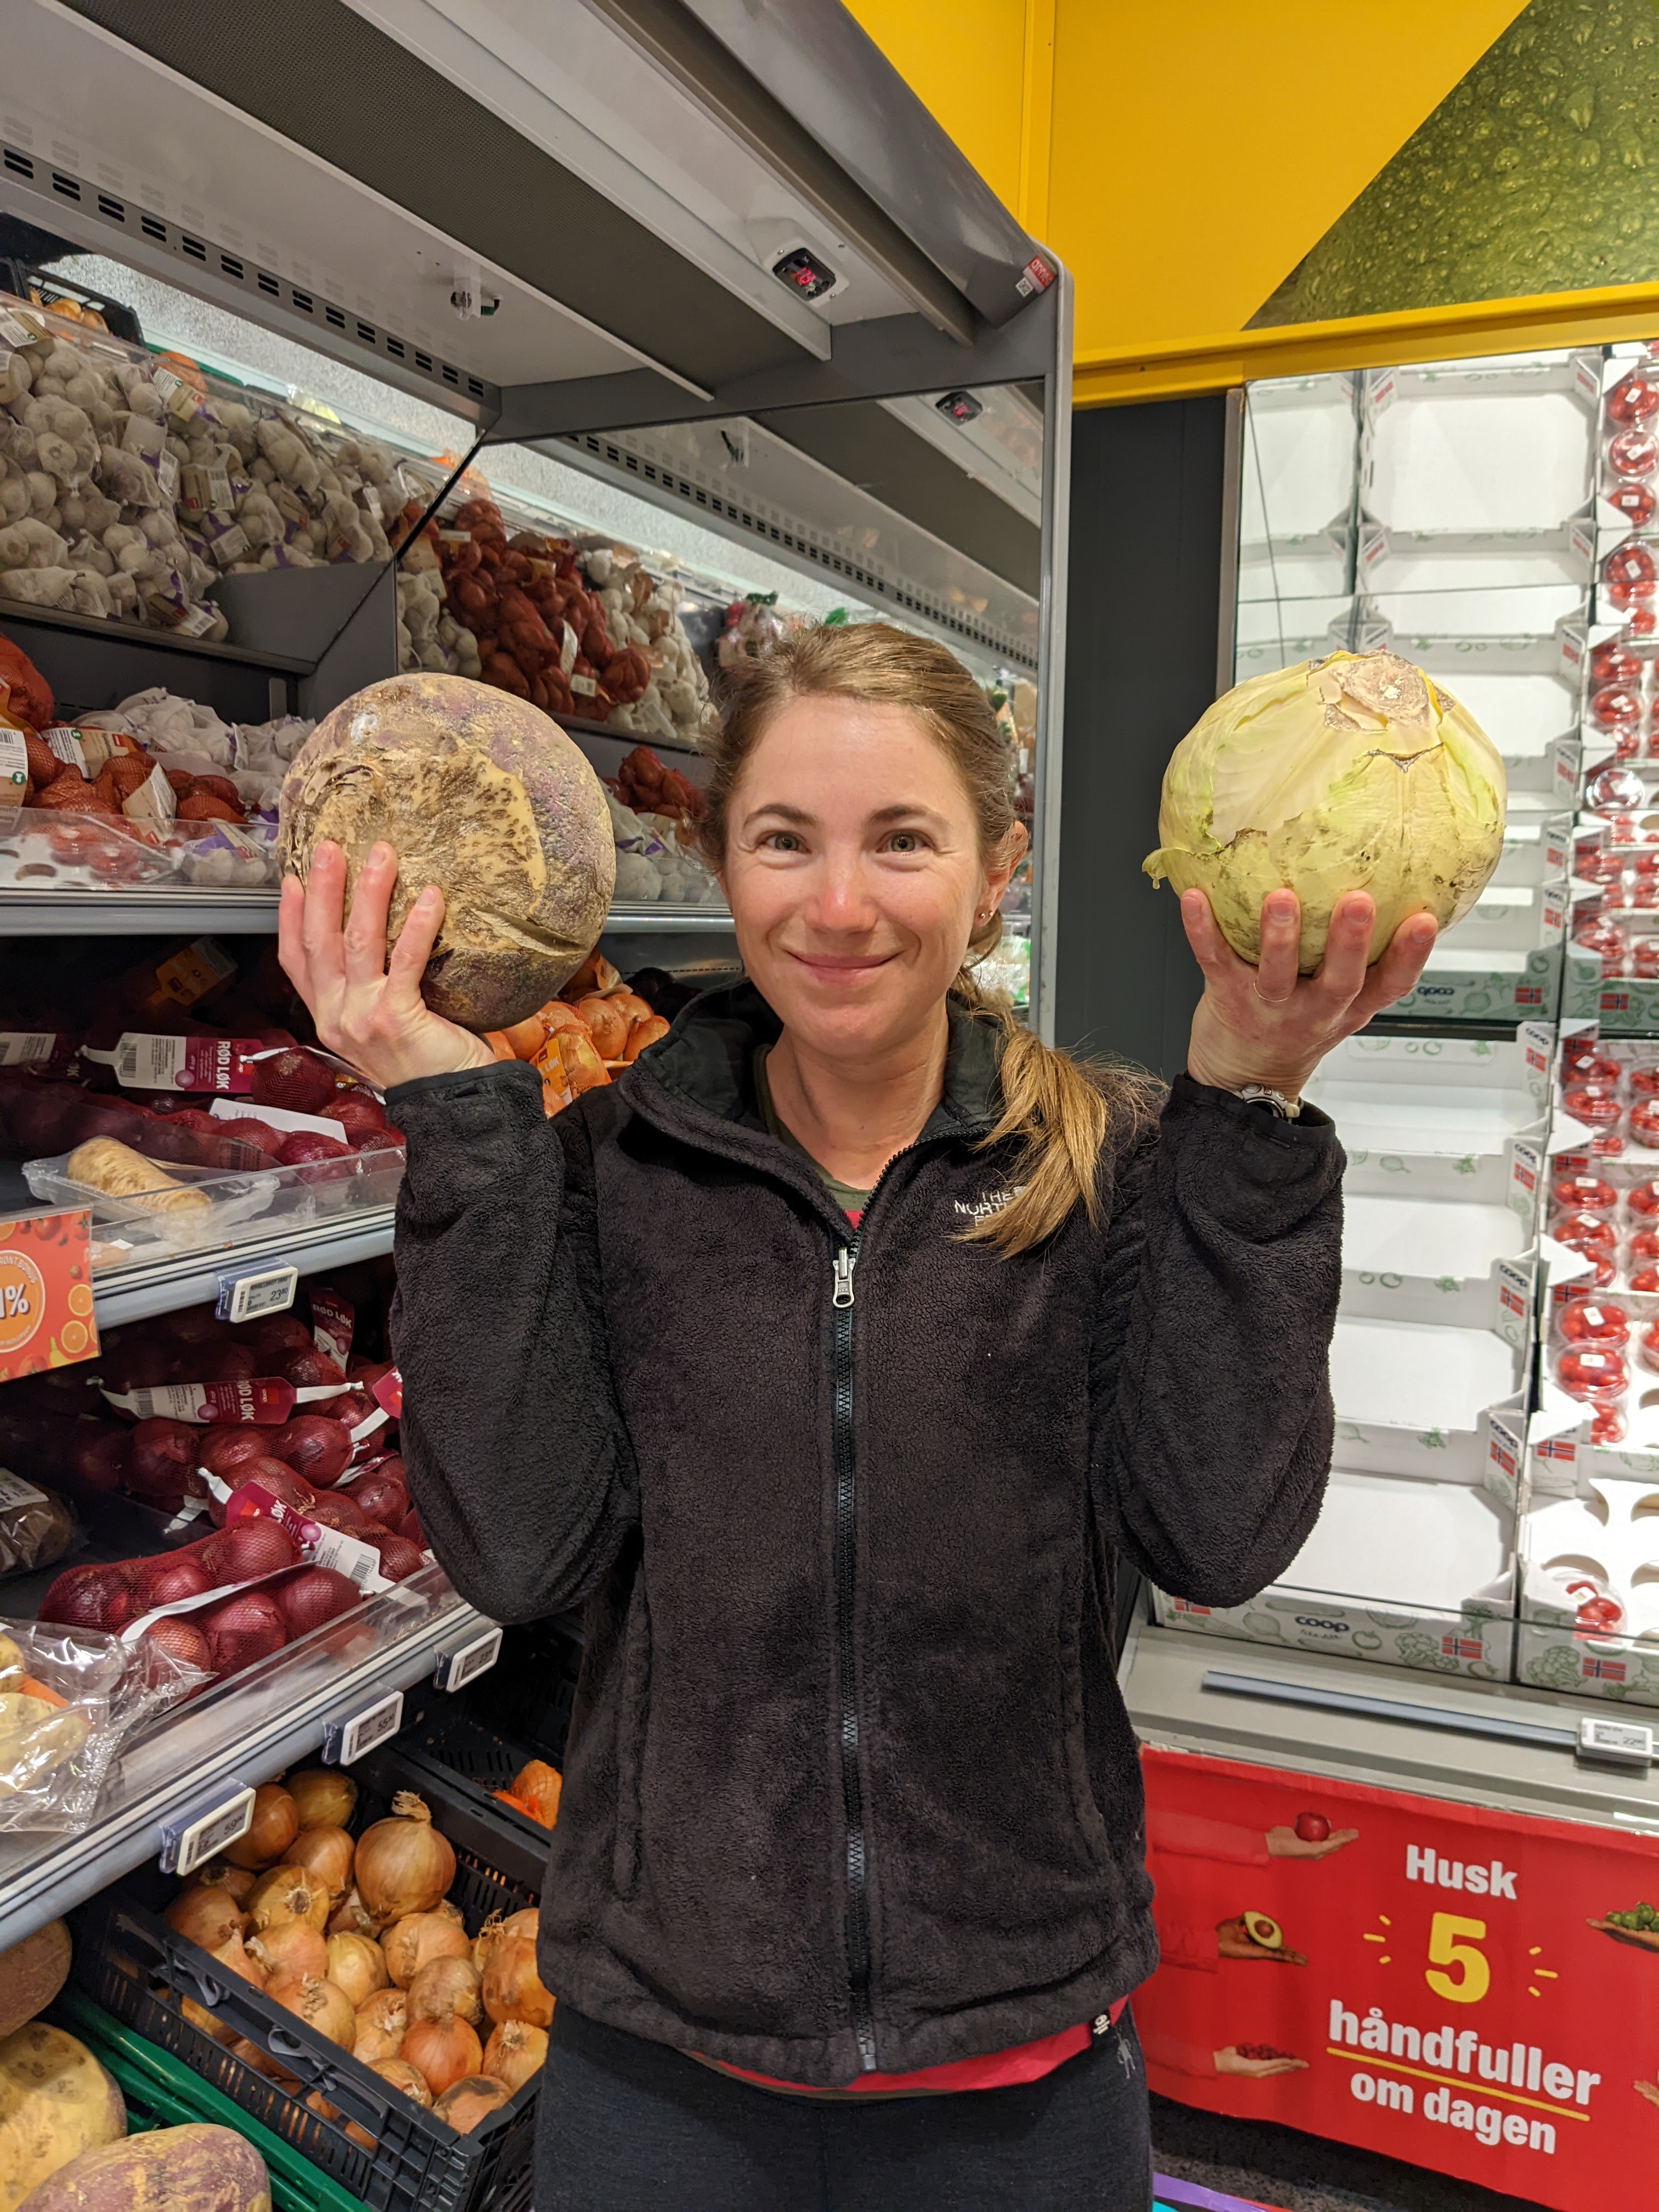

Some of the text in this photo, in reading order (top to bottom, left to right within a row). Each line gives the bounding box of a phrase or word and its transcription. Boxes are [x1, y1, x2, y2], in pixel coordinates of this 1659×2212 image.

[1525, 1027, 1549, 1045] coop
[216, 1040, 231, 1090] RØD LØK
[1514, 1143, 1537, 1164] coop
[1499, 1264, 1528, 1288] coop
[313, 1304, 352, 1328] RØD LØK
[240, 1397, 256, 1421] LØK
[1489, 1419, 1519, 1448] coop
[1295, 1616, 1350, 1632] coop
[1406, 1844, 1518, 1900] Husk
[1425, 1912, 1490, 2003] 5
[1329, 1999, 1601, 2106] håndfuller
[1351, 2073, 1556, 2154] om dagen
